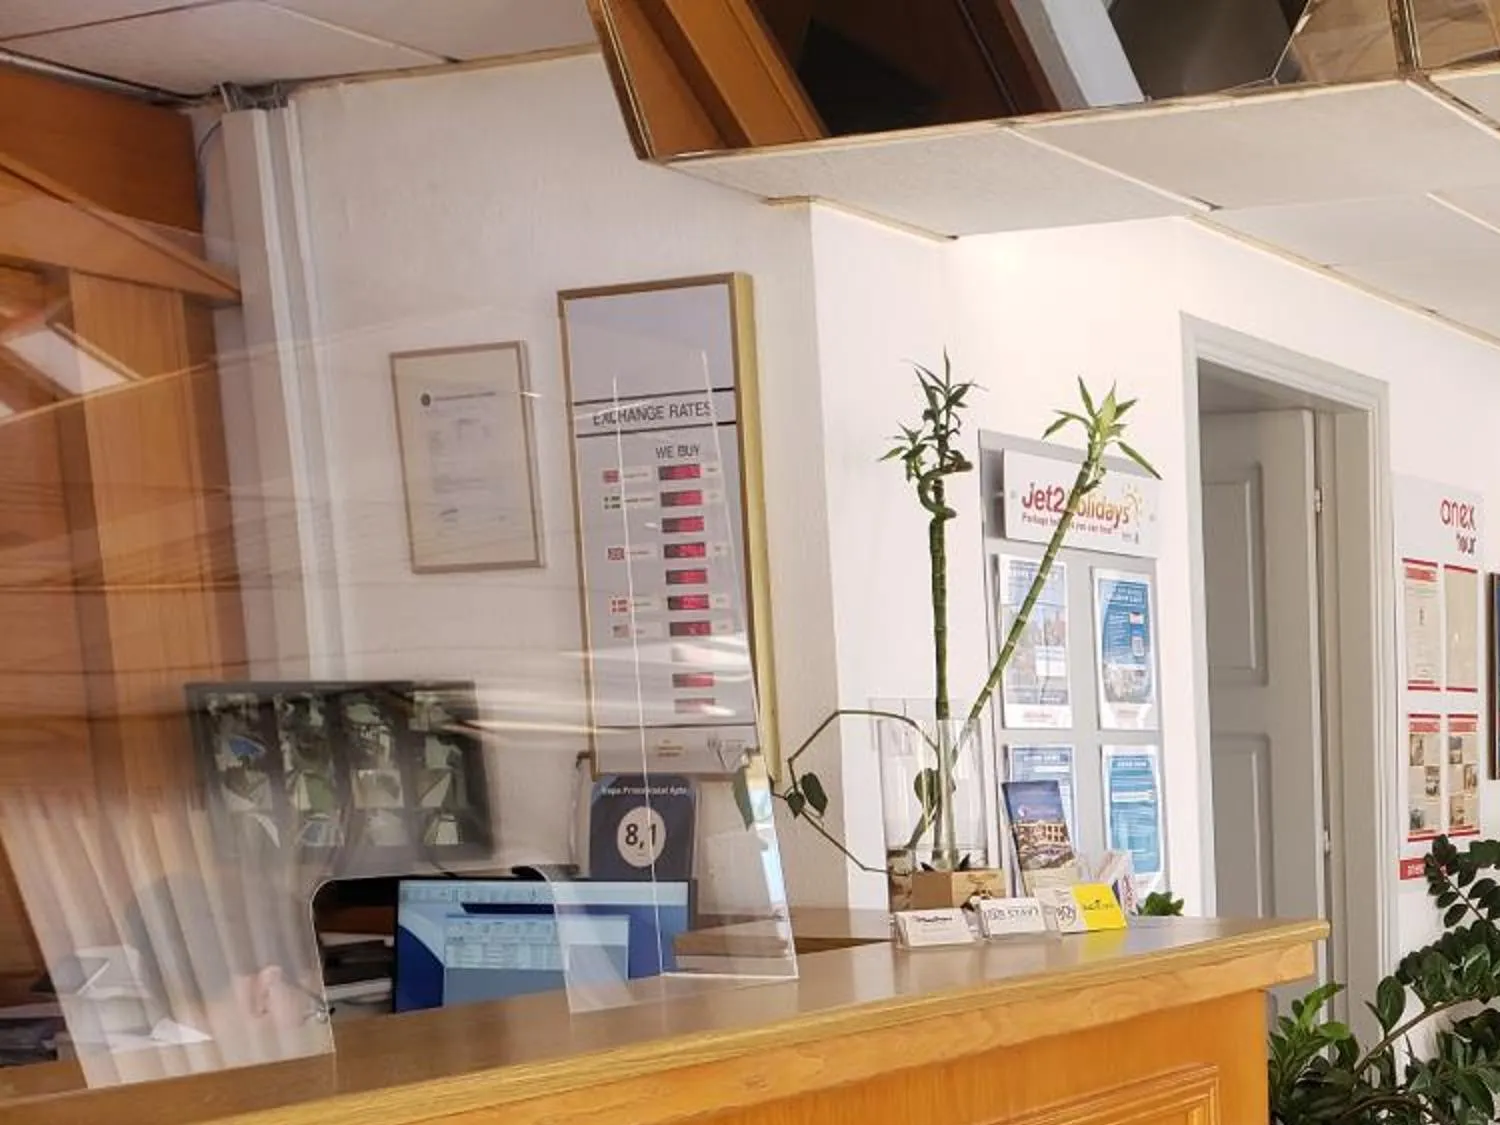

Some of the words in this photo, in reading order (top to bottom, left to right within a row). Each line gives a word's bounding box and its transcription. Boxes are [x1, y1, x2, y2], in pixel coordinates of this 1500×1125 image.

[593, 405, 665, 426] EXCHANGE
[669, 401, 713, 419] RATES
[656, 446, 674, 458] WE
[678, 444, 700, 457] BUY
[1022, 482, 1130, 528] Jet2olidays
[625, 823, 657, 849] 8,1
